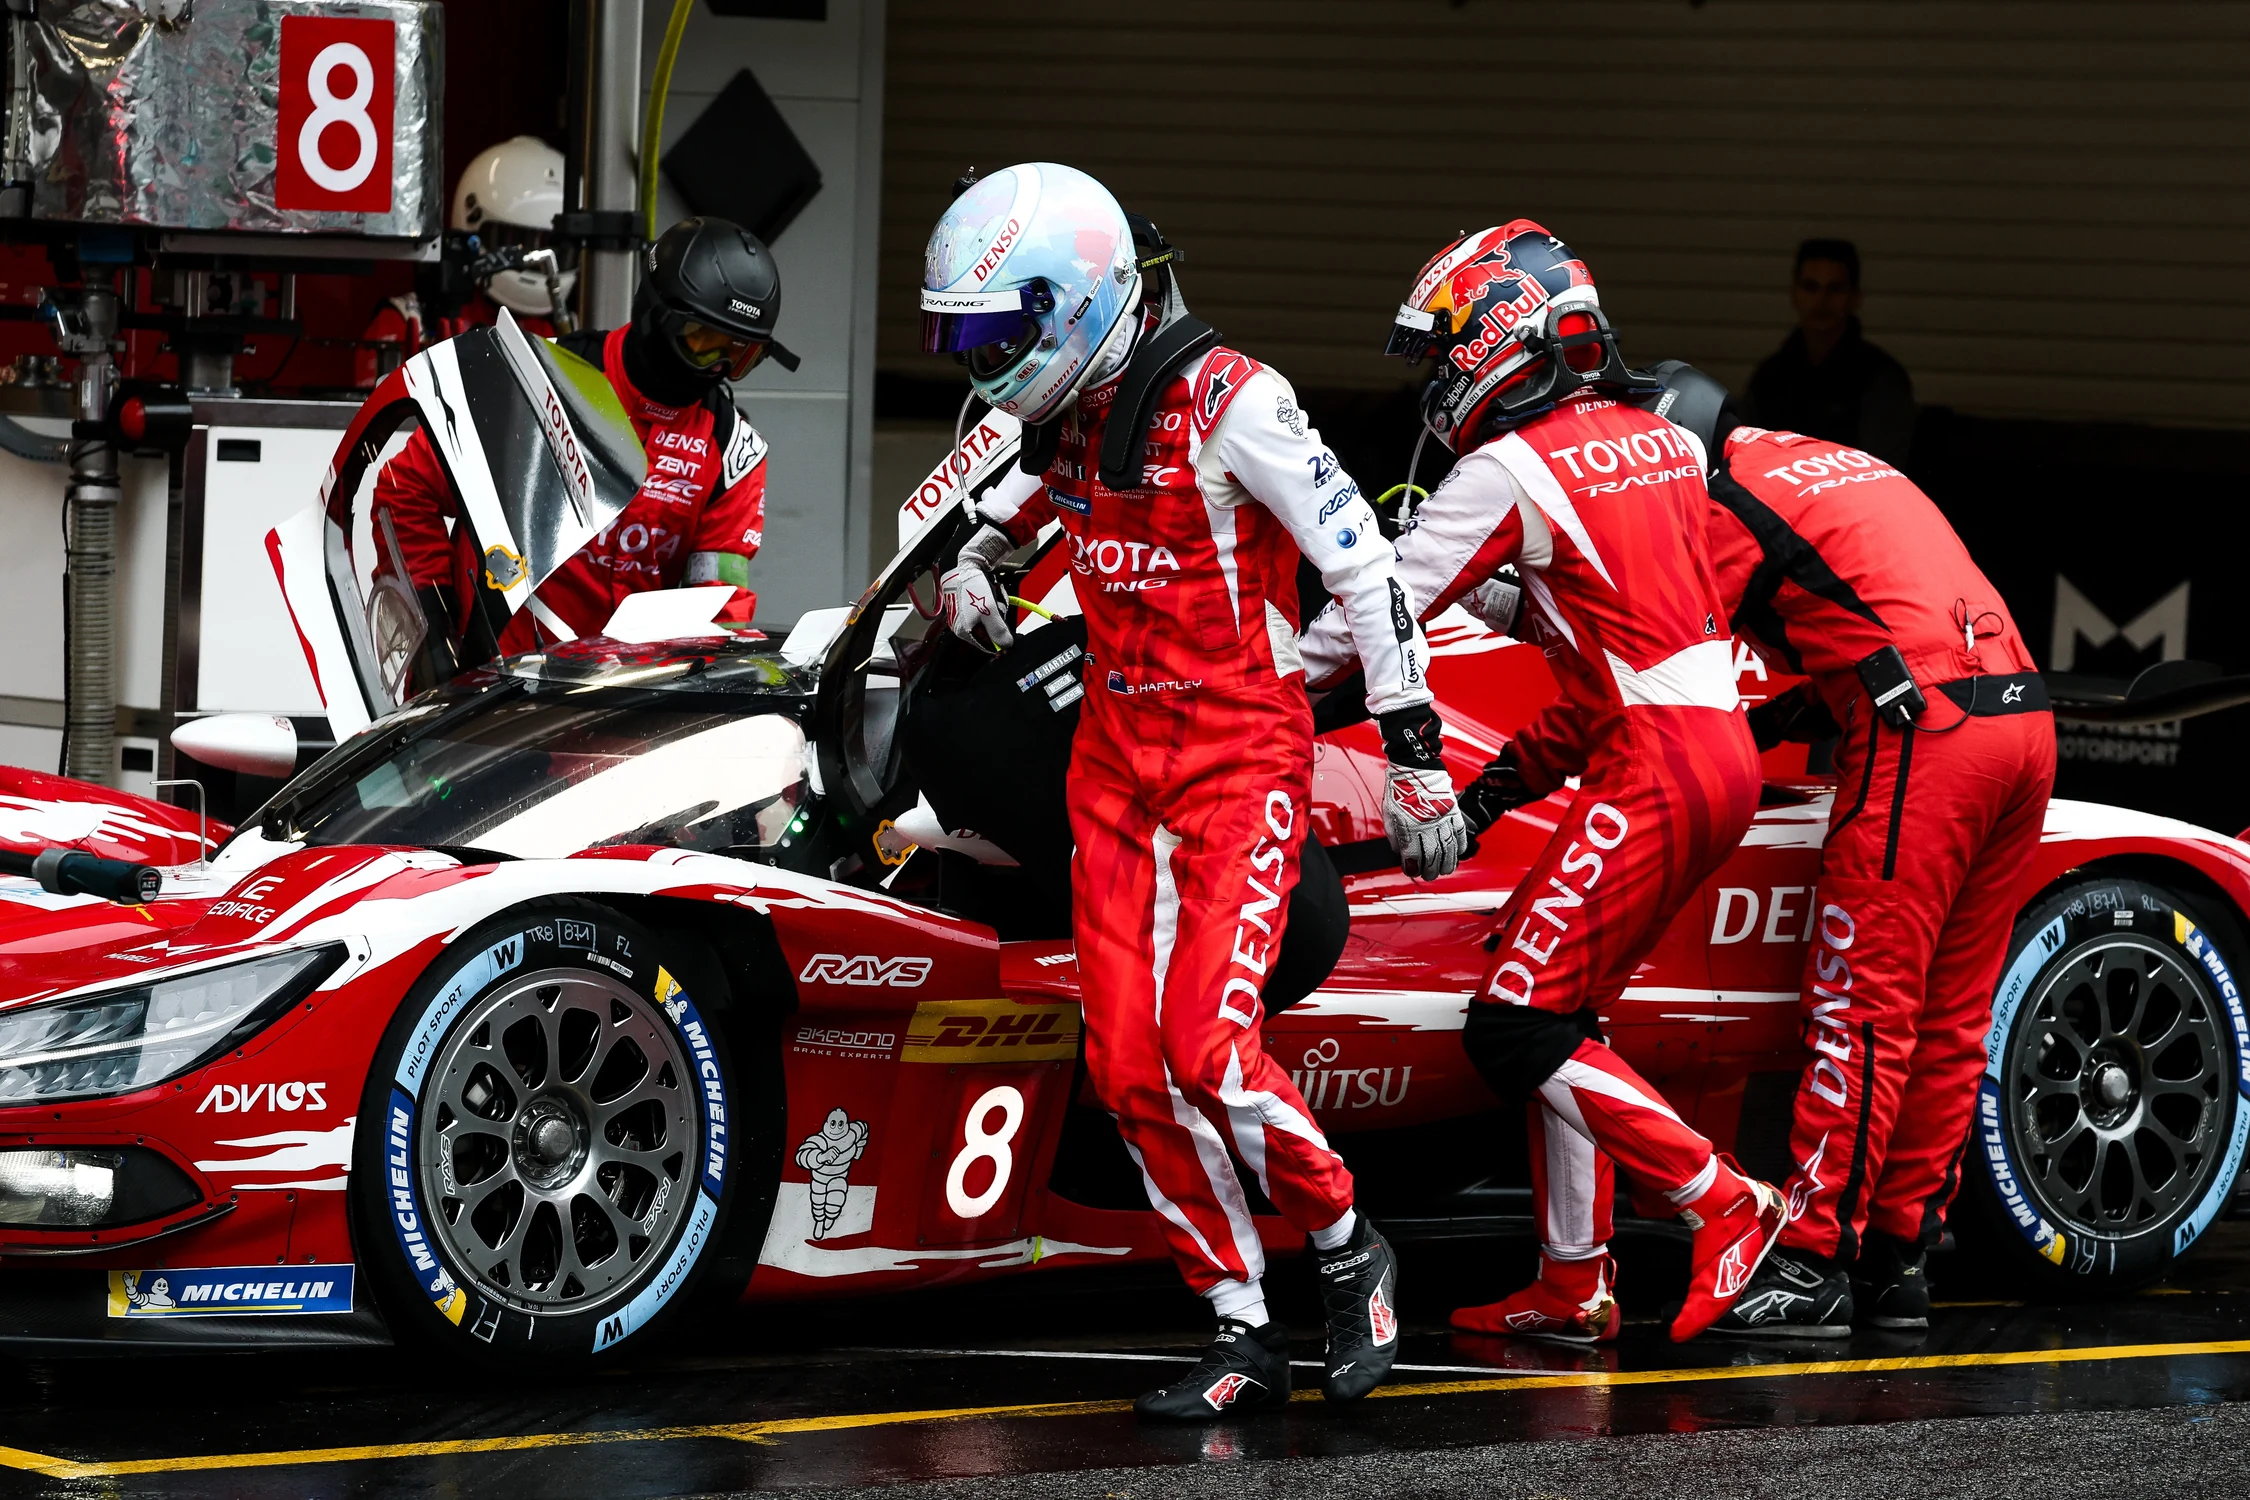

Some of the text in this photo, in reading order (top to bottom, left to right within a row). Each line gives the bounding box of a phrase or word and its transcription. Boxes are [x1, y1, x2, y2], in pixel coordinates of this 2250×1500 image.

[298, 42, 378, 192] 8
[973, 218, 1020, 282] DENSO
[731, 299, 760, 316] TOYOTA
[925, 297, 991, 307] RACING
[1410, 256, 1453, 308] DENSO
[1449, 273, 1551, 372] Red Bull
[1018, 363, 1037, 380] BELL
[1479, 373, 1501, 394] MILLE
[1456, 392, 1480, 422] RICHARD
[546, 386, 588, 498] TOYOTA
[655, 455, 702, 478] ZENT
[1549, 427, 1694, 479] TOYOTA
[903, 424, 1002, 521] TOYOTA
[1315, 480, 1328, 489] LE
[1573, 464, 1701, 498] RACING
[1054, 494, 1087, 510] MICHELIN
[1034, 648, 1077, 680] B.HARTLEY
[1127, 679, 1202, 695] B.HARTLEY
[207, 900, 276, 924] EDIFICE
[1218, 789, 1294, 1030] DENSO
[1487, 802, 1630, 1007] DENSO
[492, 940, 519, 970] W
[616, 935, 632, 958] FL
[2041, 924, 2060, 954] W
[799, 953, 933, 987] RAYS
[930, 1013, 1063, 1047] DHL
[1810, 903, 1856, 1108] DENSO
[1988, 973, 2023, 1065] PILOT SPORT
[2203, 949, 2250, 1083] MICHELIN
[406, 984, 464, 1080] PILOT SPORT
[793, 1046, 891, 1060] BRAKE EXPERTS
[797, 1027, 896, 1047] akebono
[683, 1020, 723, 1184] MICHELIN
[440, 1134, 456, 1195] RAYS
[945, 1085, 1024, 1219] 8
[1982, 1092, 2037, 1229] MICHELIN
[2217, 1111, 2249, 1201] PILOT SPORT
[389, 1106, 436, 1273] MICHELIN
[643, 1177, 670, 1237] RAYS
[655, 1209, 709, 1303] PILOT SPORT
[180, 1281, 335, 1302] MICHELIN
